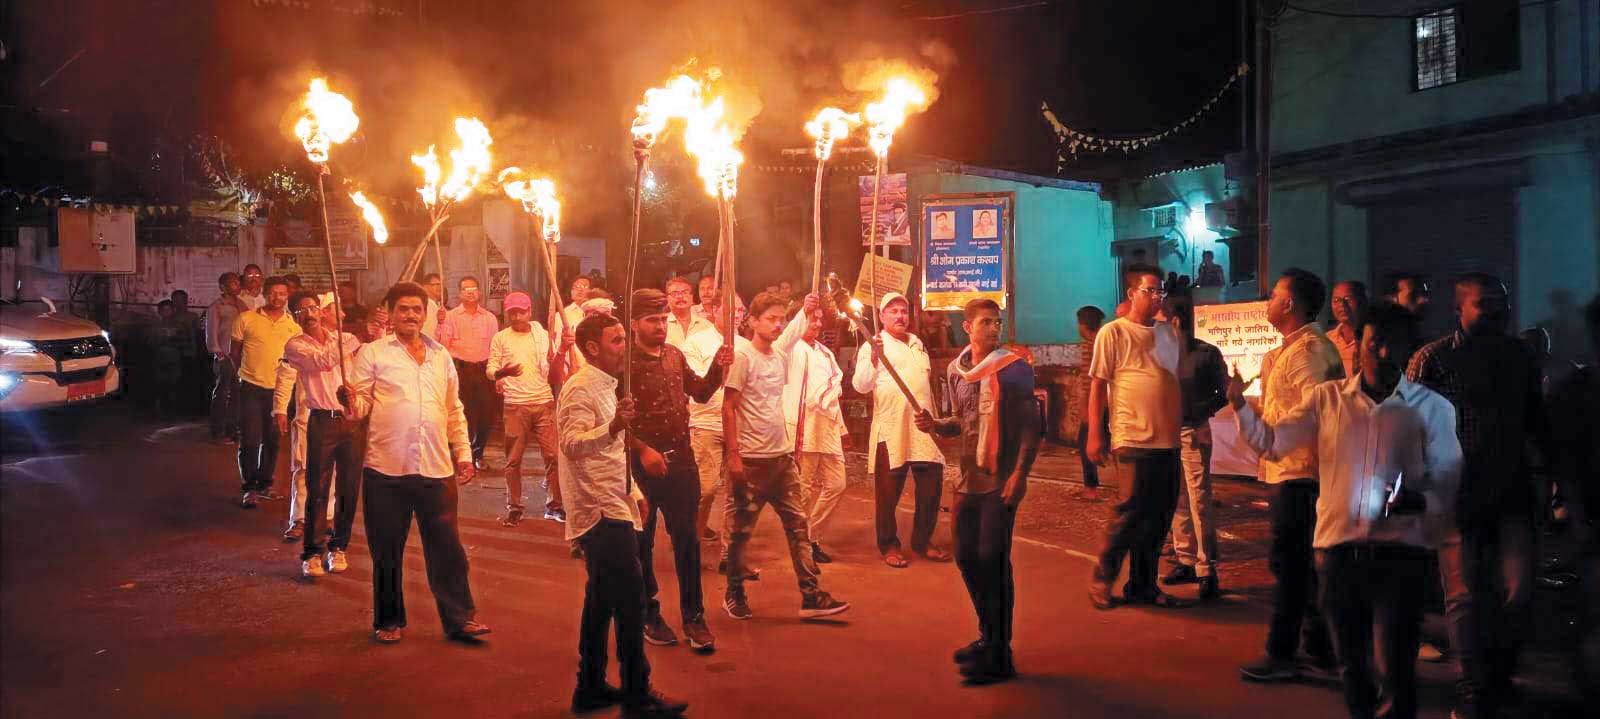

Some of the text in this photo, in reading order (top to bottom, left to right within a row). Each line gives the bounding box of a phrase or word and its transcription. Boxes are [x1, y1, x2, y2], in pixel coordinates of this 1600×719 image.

[930, 253, 939, 266] श्री
[1211, 311, 1240, 322] भारतीय
[1208, 325, 1232, 336] मणिपुर
[1244, 323, 1269, 333] जातिय
